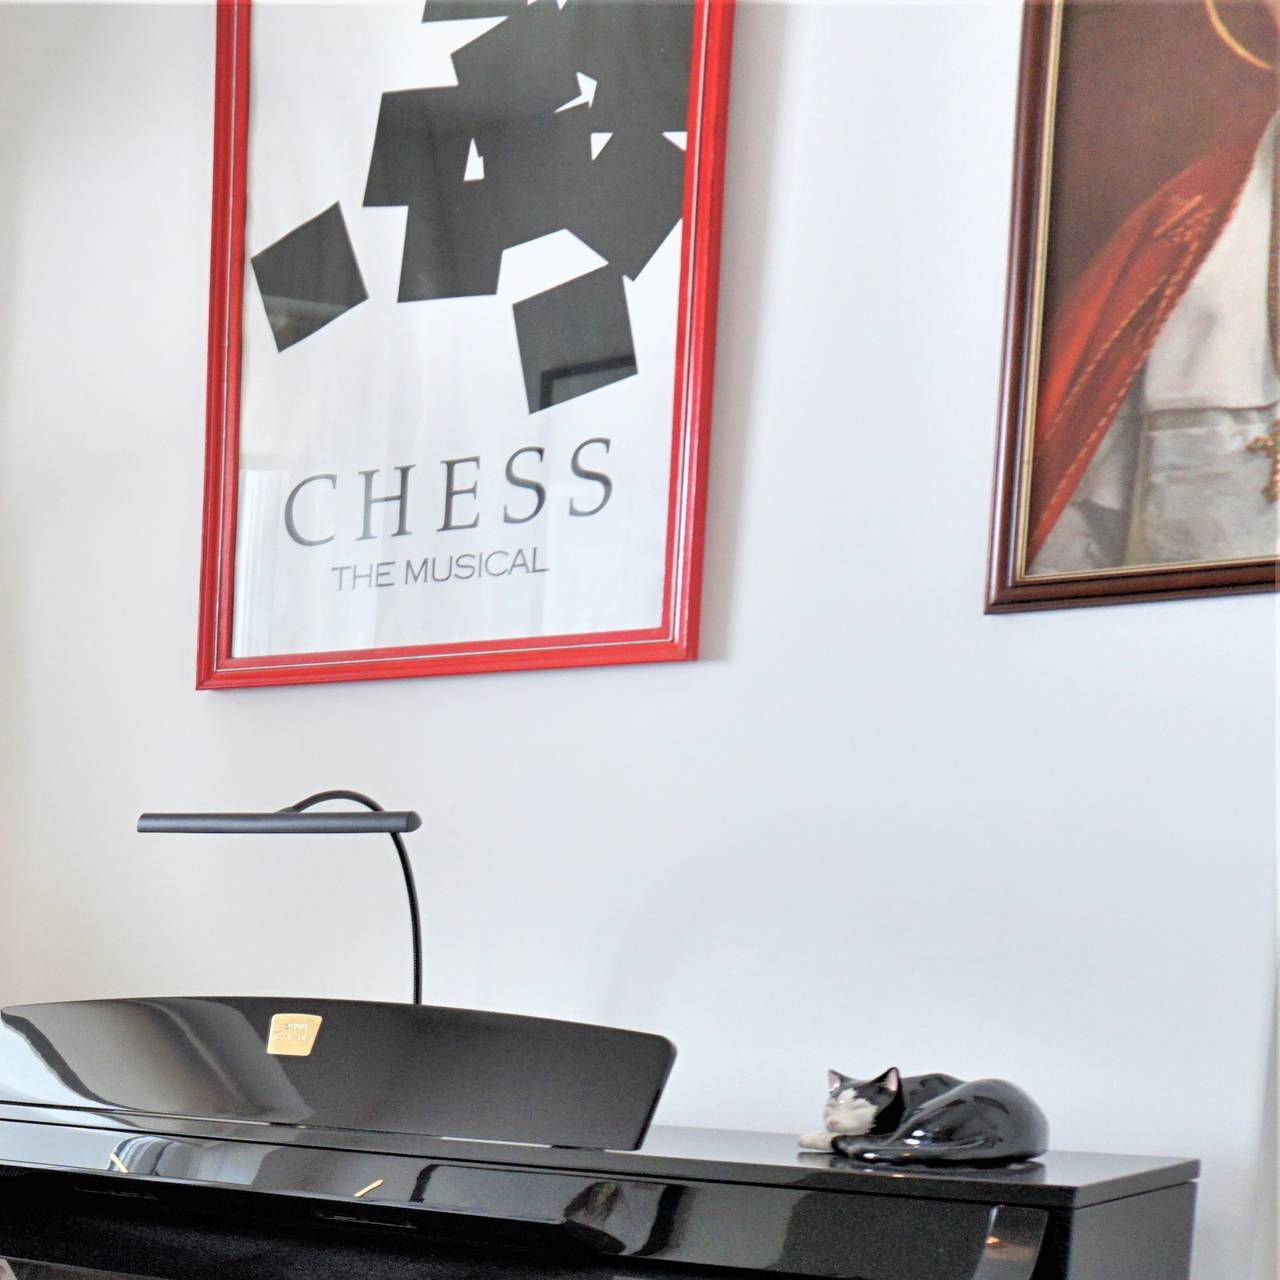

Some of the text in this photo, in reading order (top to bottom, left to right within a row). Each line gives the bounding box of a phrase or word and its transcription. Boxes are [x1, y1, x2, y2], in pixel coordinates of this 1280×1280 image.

[284, 437, 613, 546] CHESS
[332, 547, 549, 591] THE MUSICAL
